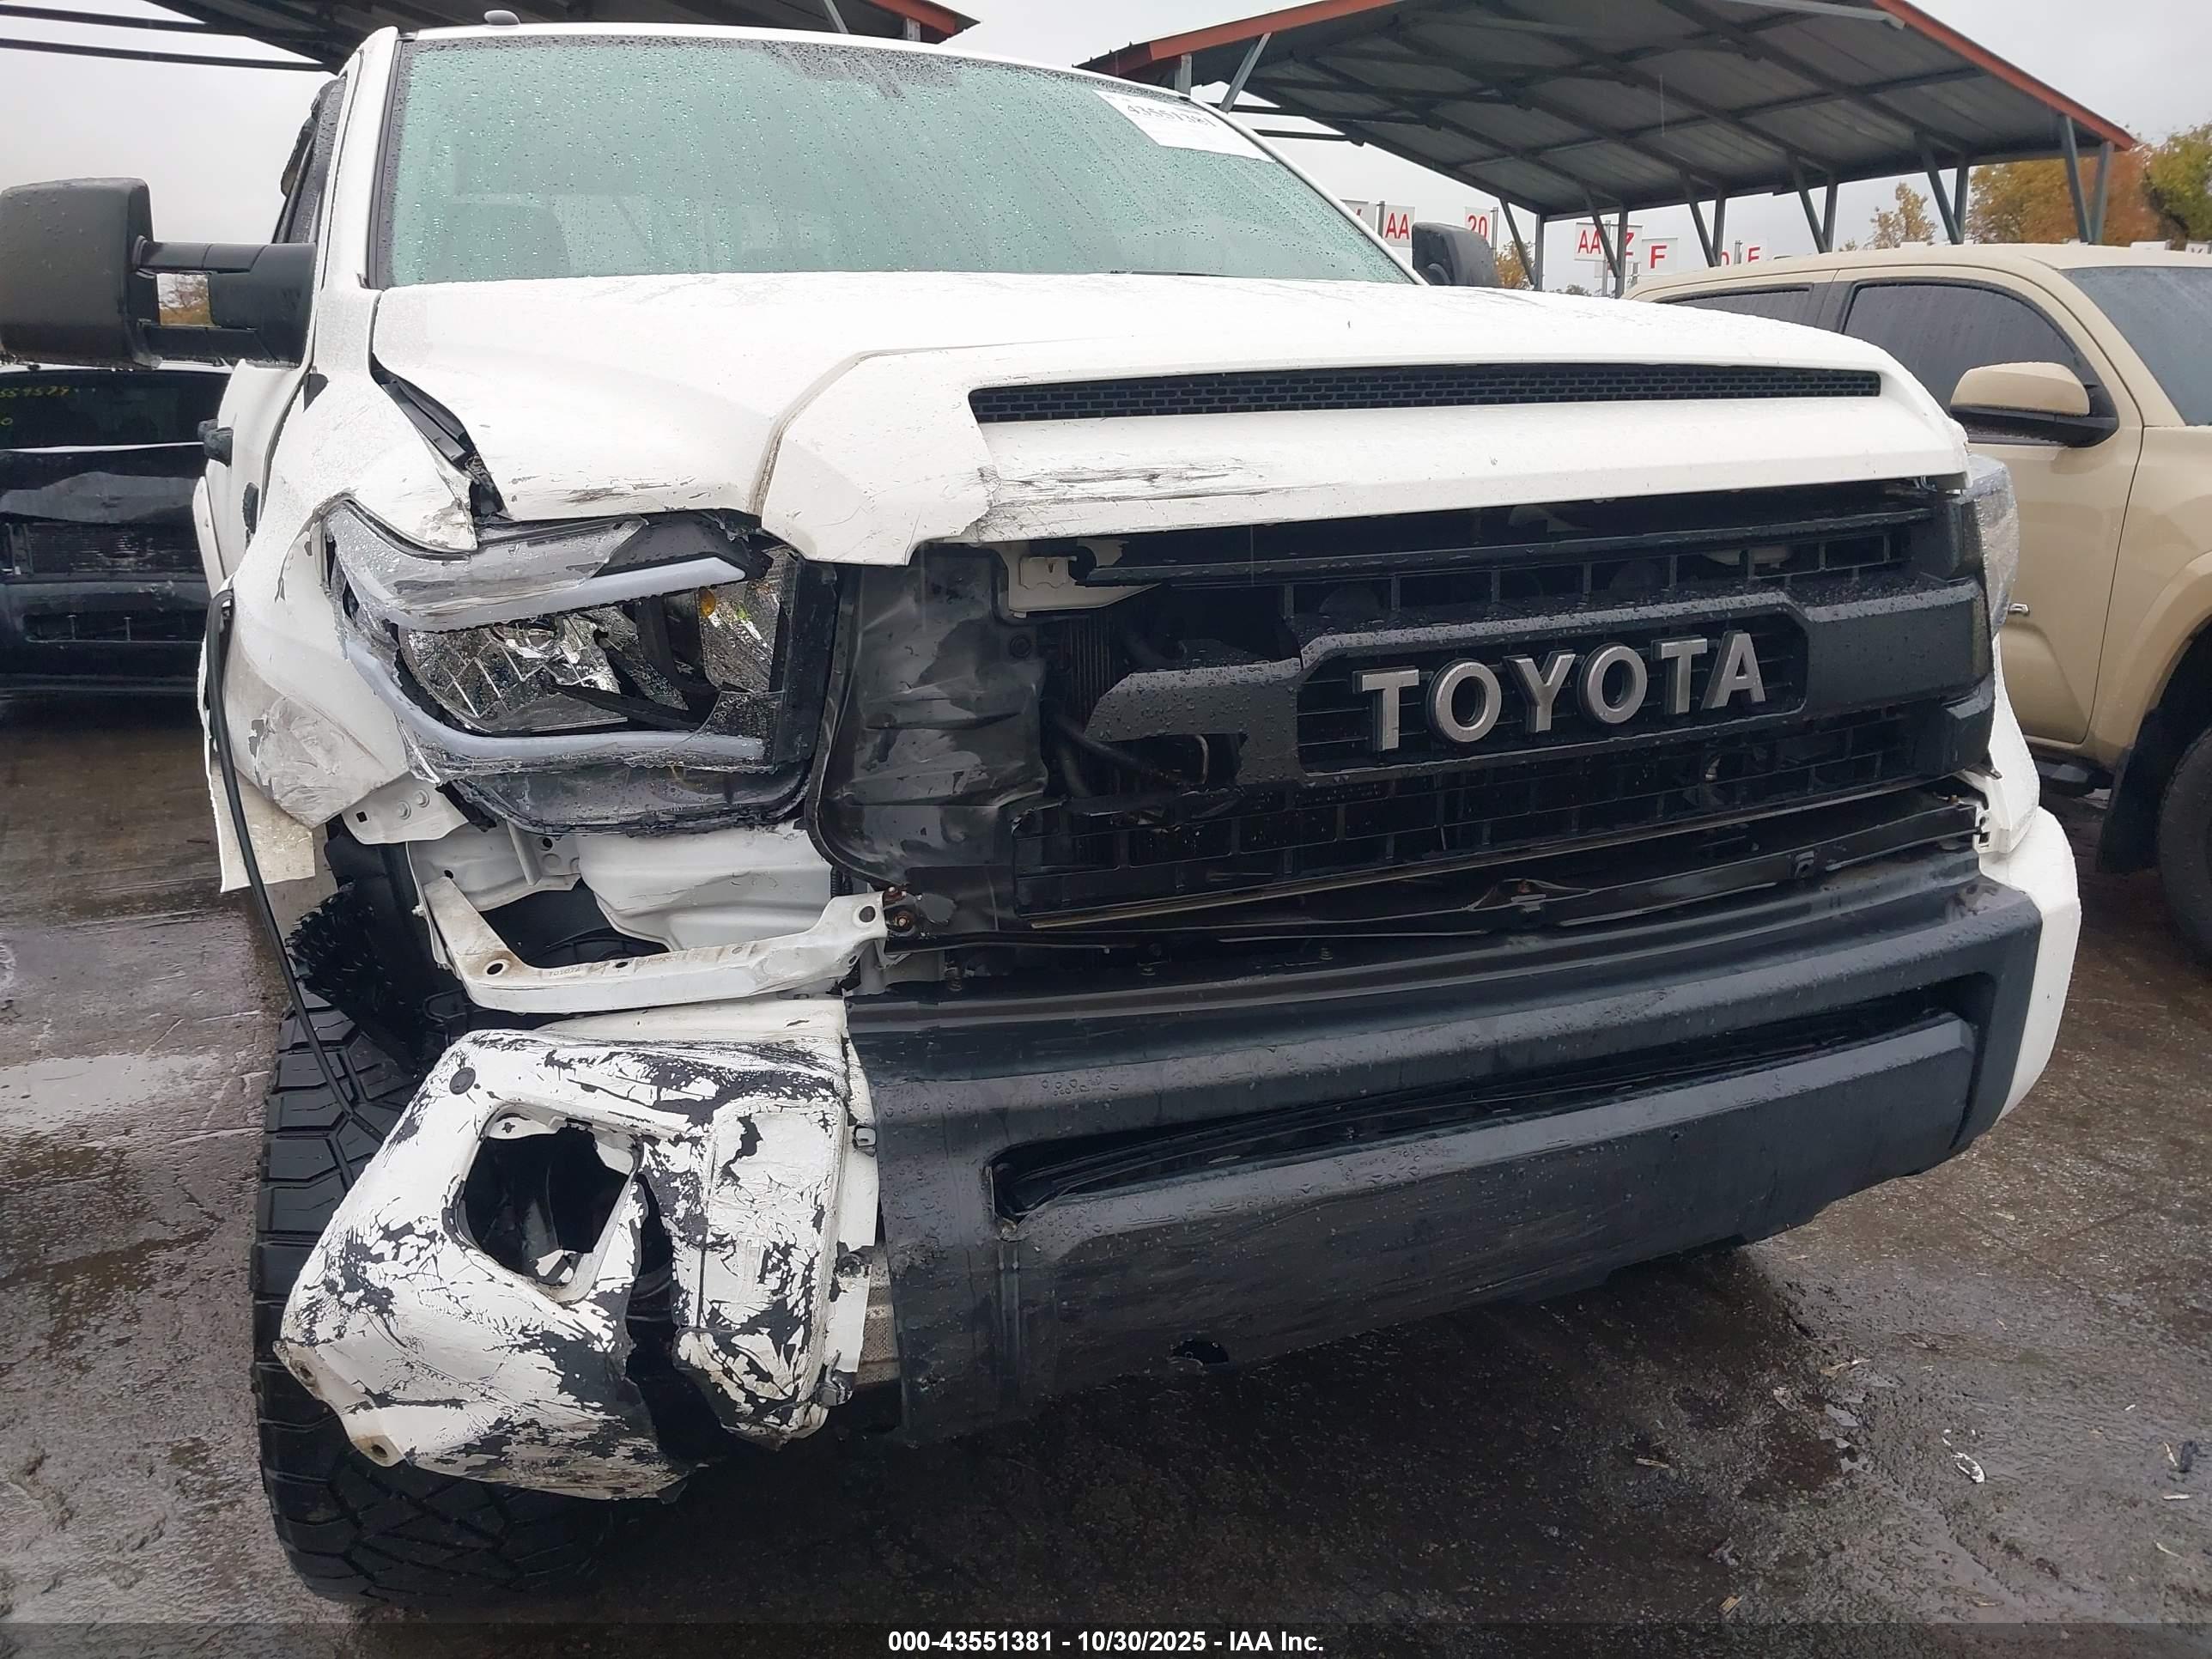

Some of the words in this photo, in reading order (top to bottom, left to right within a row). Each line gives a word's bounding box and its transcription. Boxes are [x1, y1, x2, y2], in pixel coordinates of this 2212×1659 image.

[1384, 212, 1410, 240] AA
[1577, 229, 1601, 254] AA
[1650, 245, 1668, 269] F
[1353, 630, 1767, 750] TOYOTA
